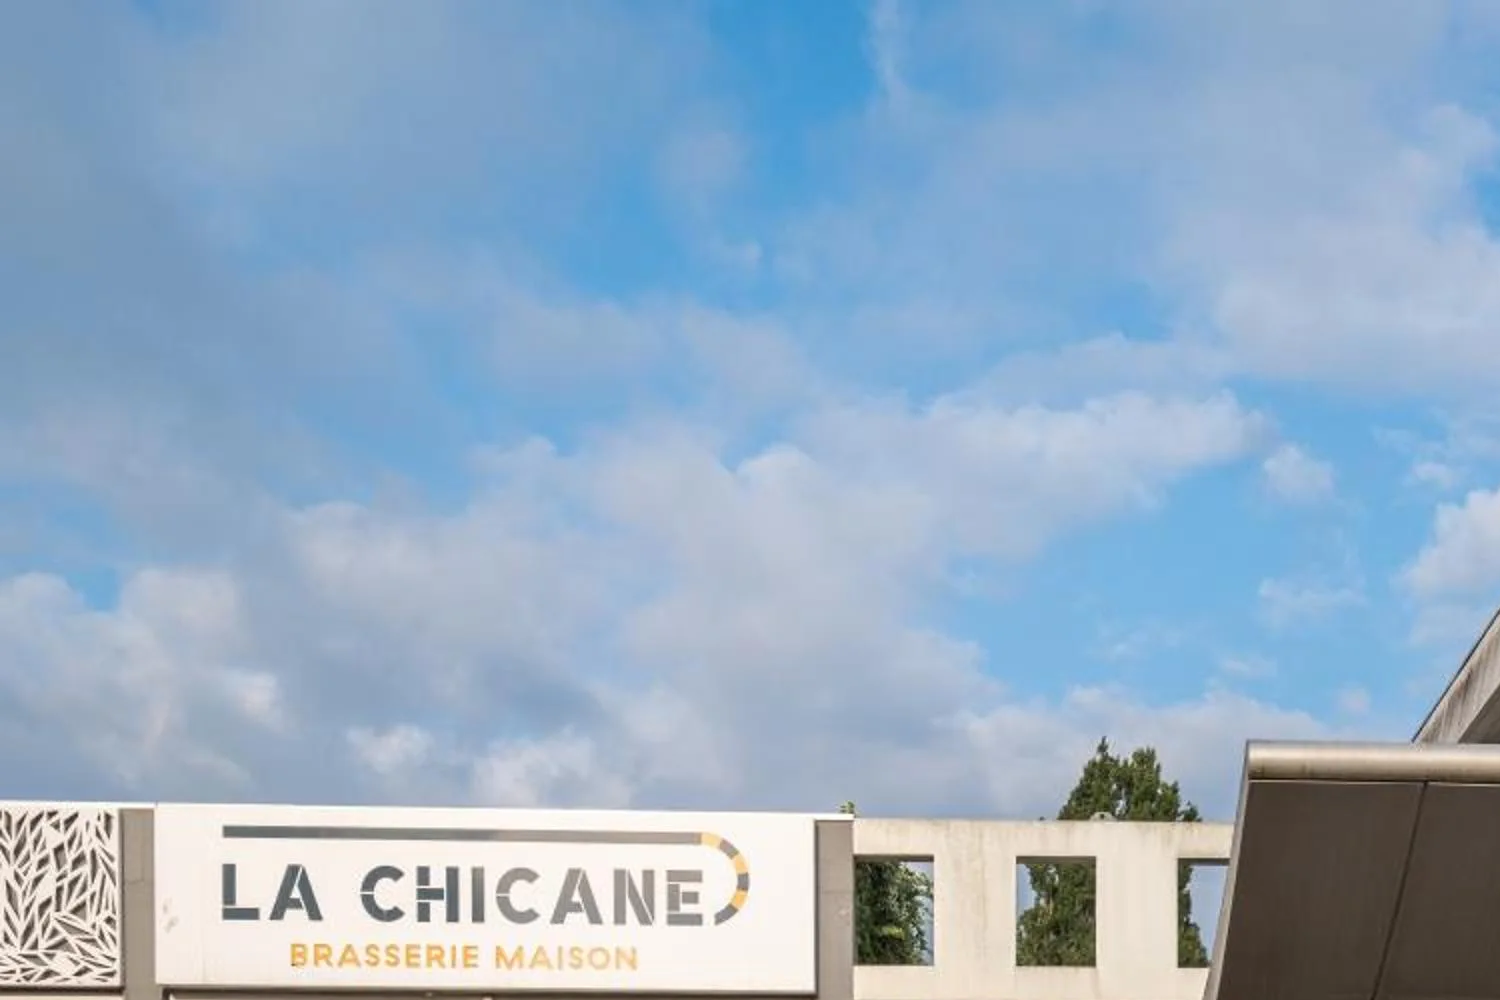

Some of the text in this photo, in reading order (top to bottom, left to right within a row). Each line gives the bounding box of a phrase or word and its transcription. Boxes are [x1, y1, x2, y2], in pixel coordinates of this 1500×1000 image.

[222, 863, 703, 926] LA CHICANE
[290, 942, 638, 972] BRASSERIE MAISON
